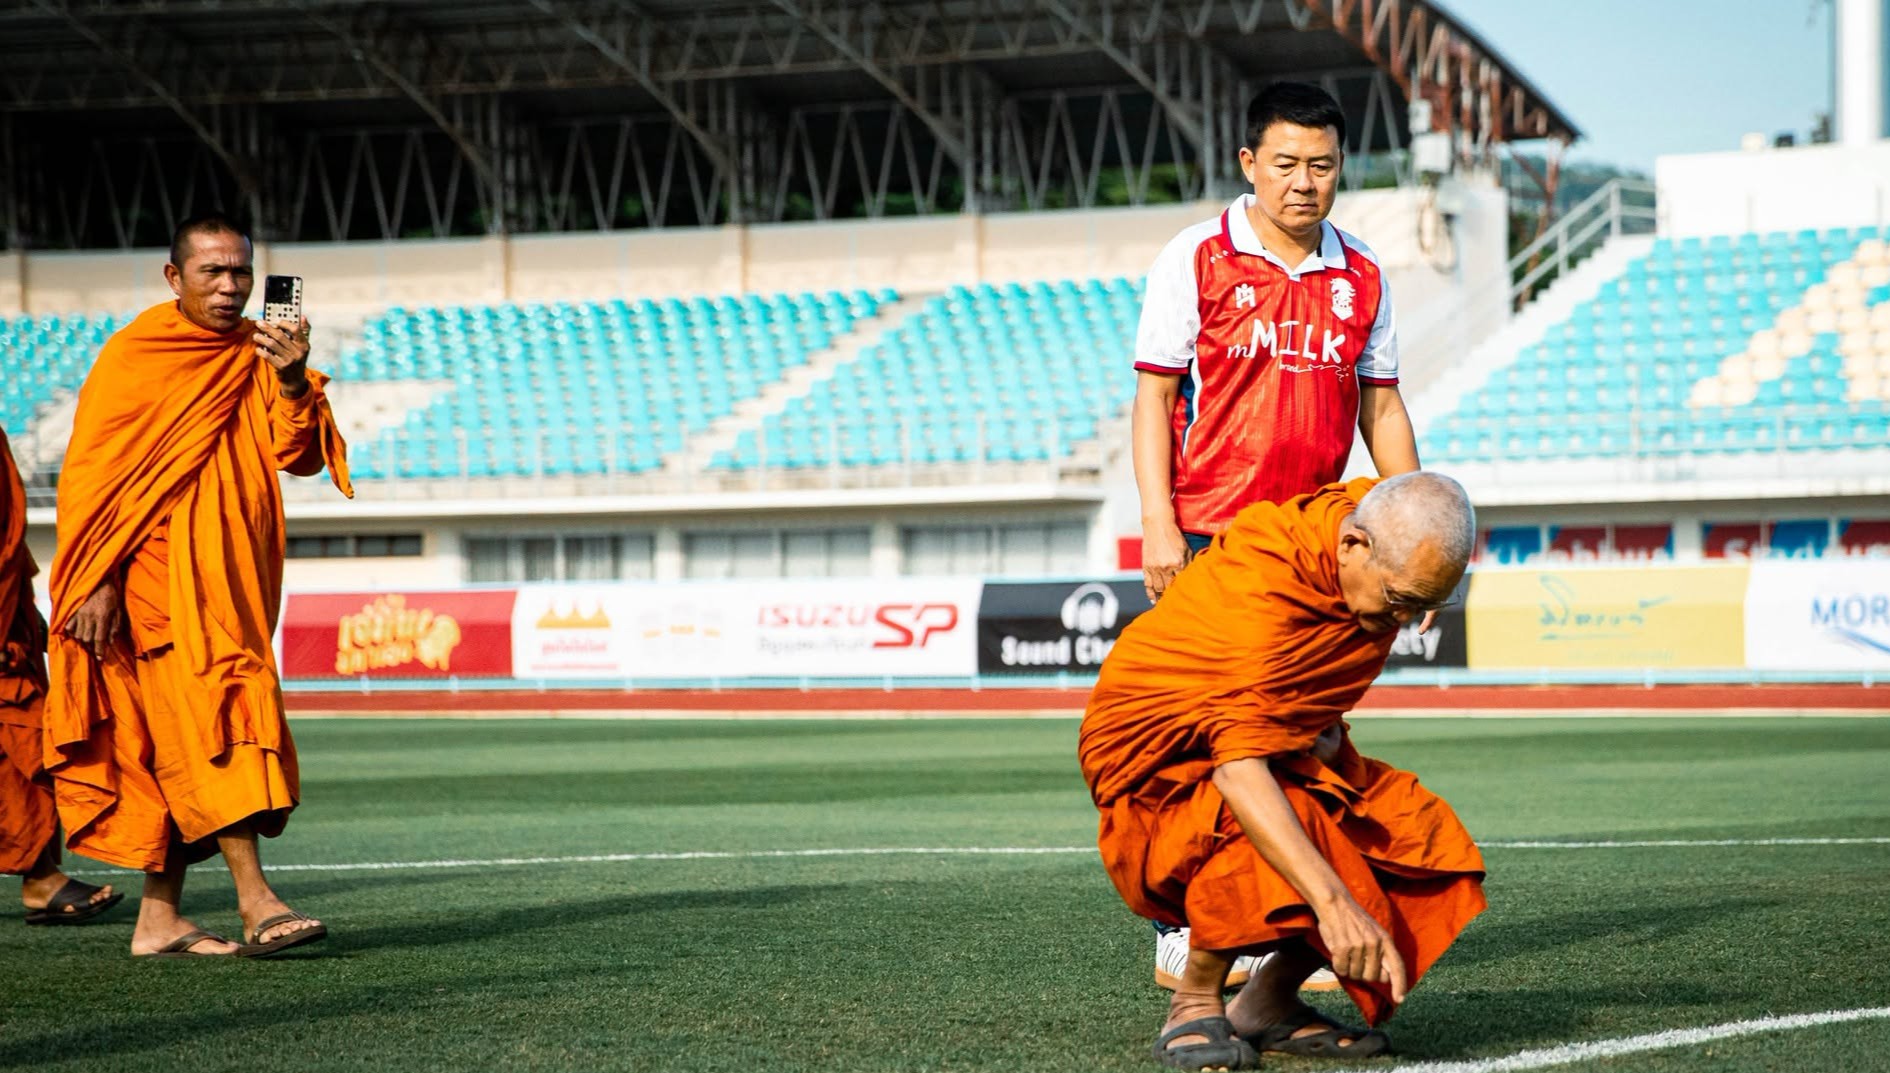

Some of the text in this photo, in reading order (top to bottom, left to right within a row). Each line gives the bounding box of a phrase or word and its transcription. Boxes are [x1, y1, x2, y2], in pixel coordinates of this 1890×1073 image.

[757, 604, 868, 627] ISUZU
[873, 602, 958, 648] SP
[1001, 635, 1071, 666] Sound
[1390, 622, 1441, 662] ety
